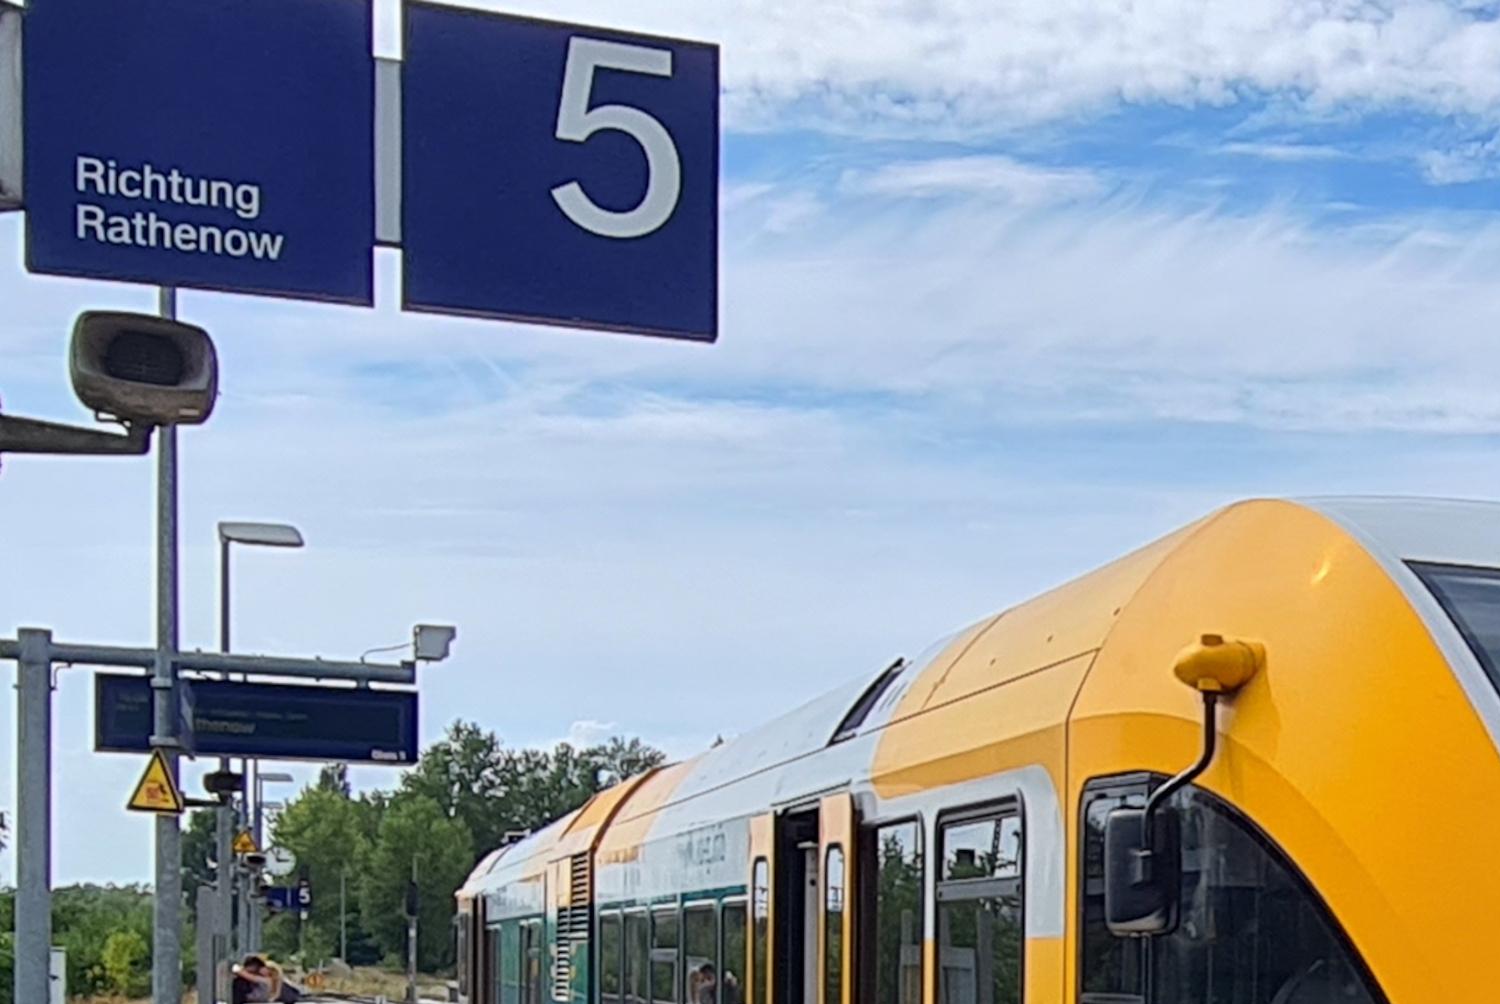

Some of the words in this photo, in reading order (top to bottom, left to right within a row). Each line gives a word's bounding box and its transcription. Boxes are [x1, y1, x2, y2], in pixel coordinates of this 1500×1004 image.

[549, 35, 682, 239] 5
[76, 156, 260, 217] Richtung
[76, 204, 284, 260] Rathenow
[299, 887, 311, 904] 5
